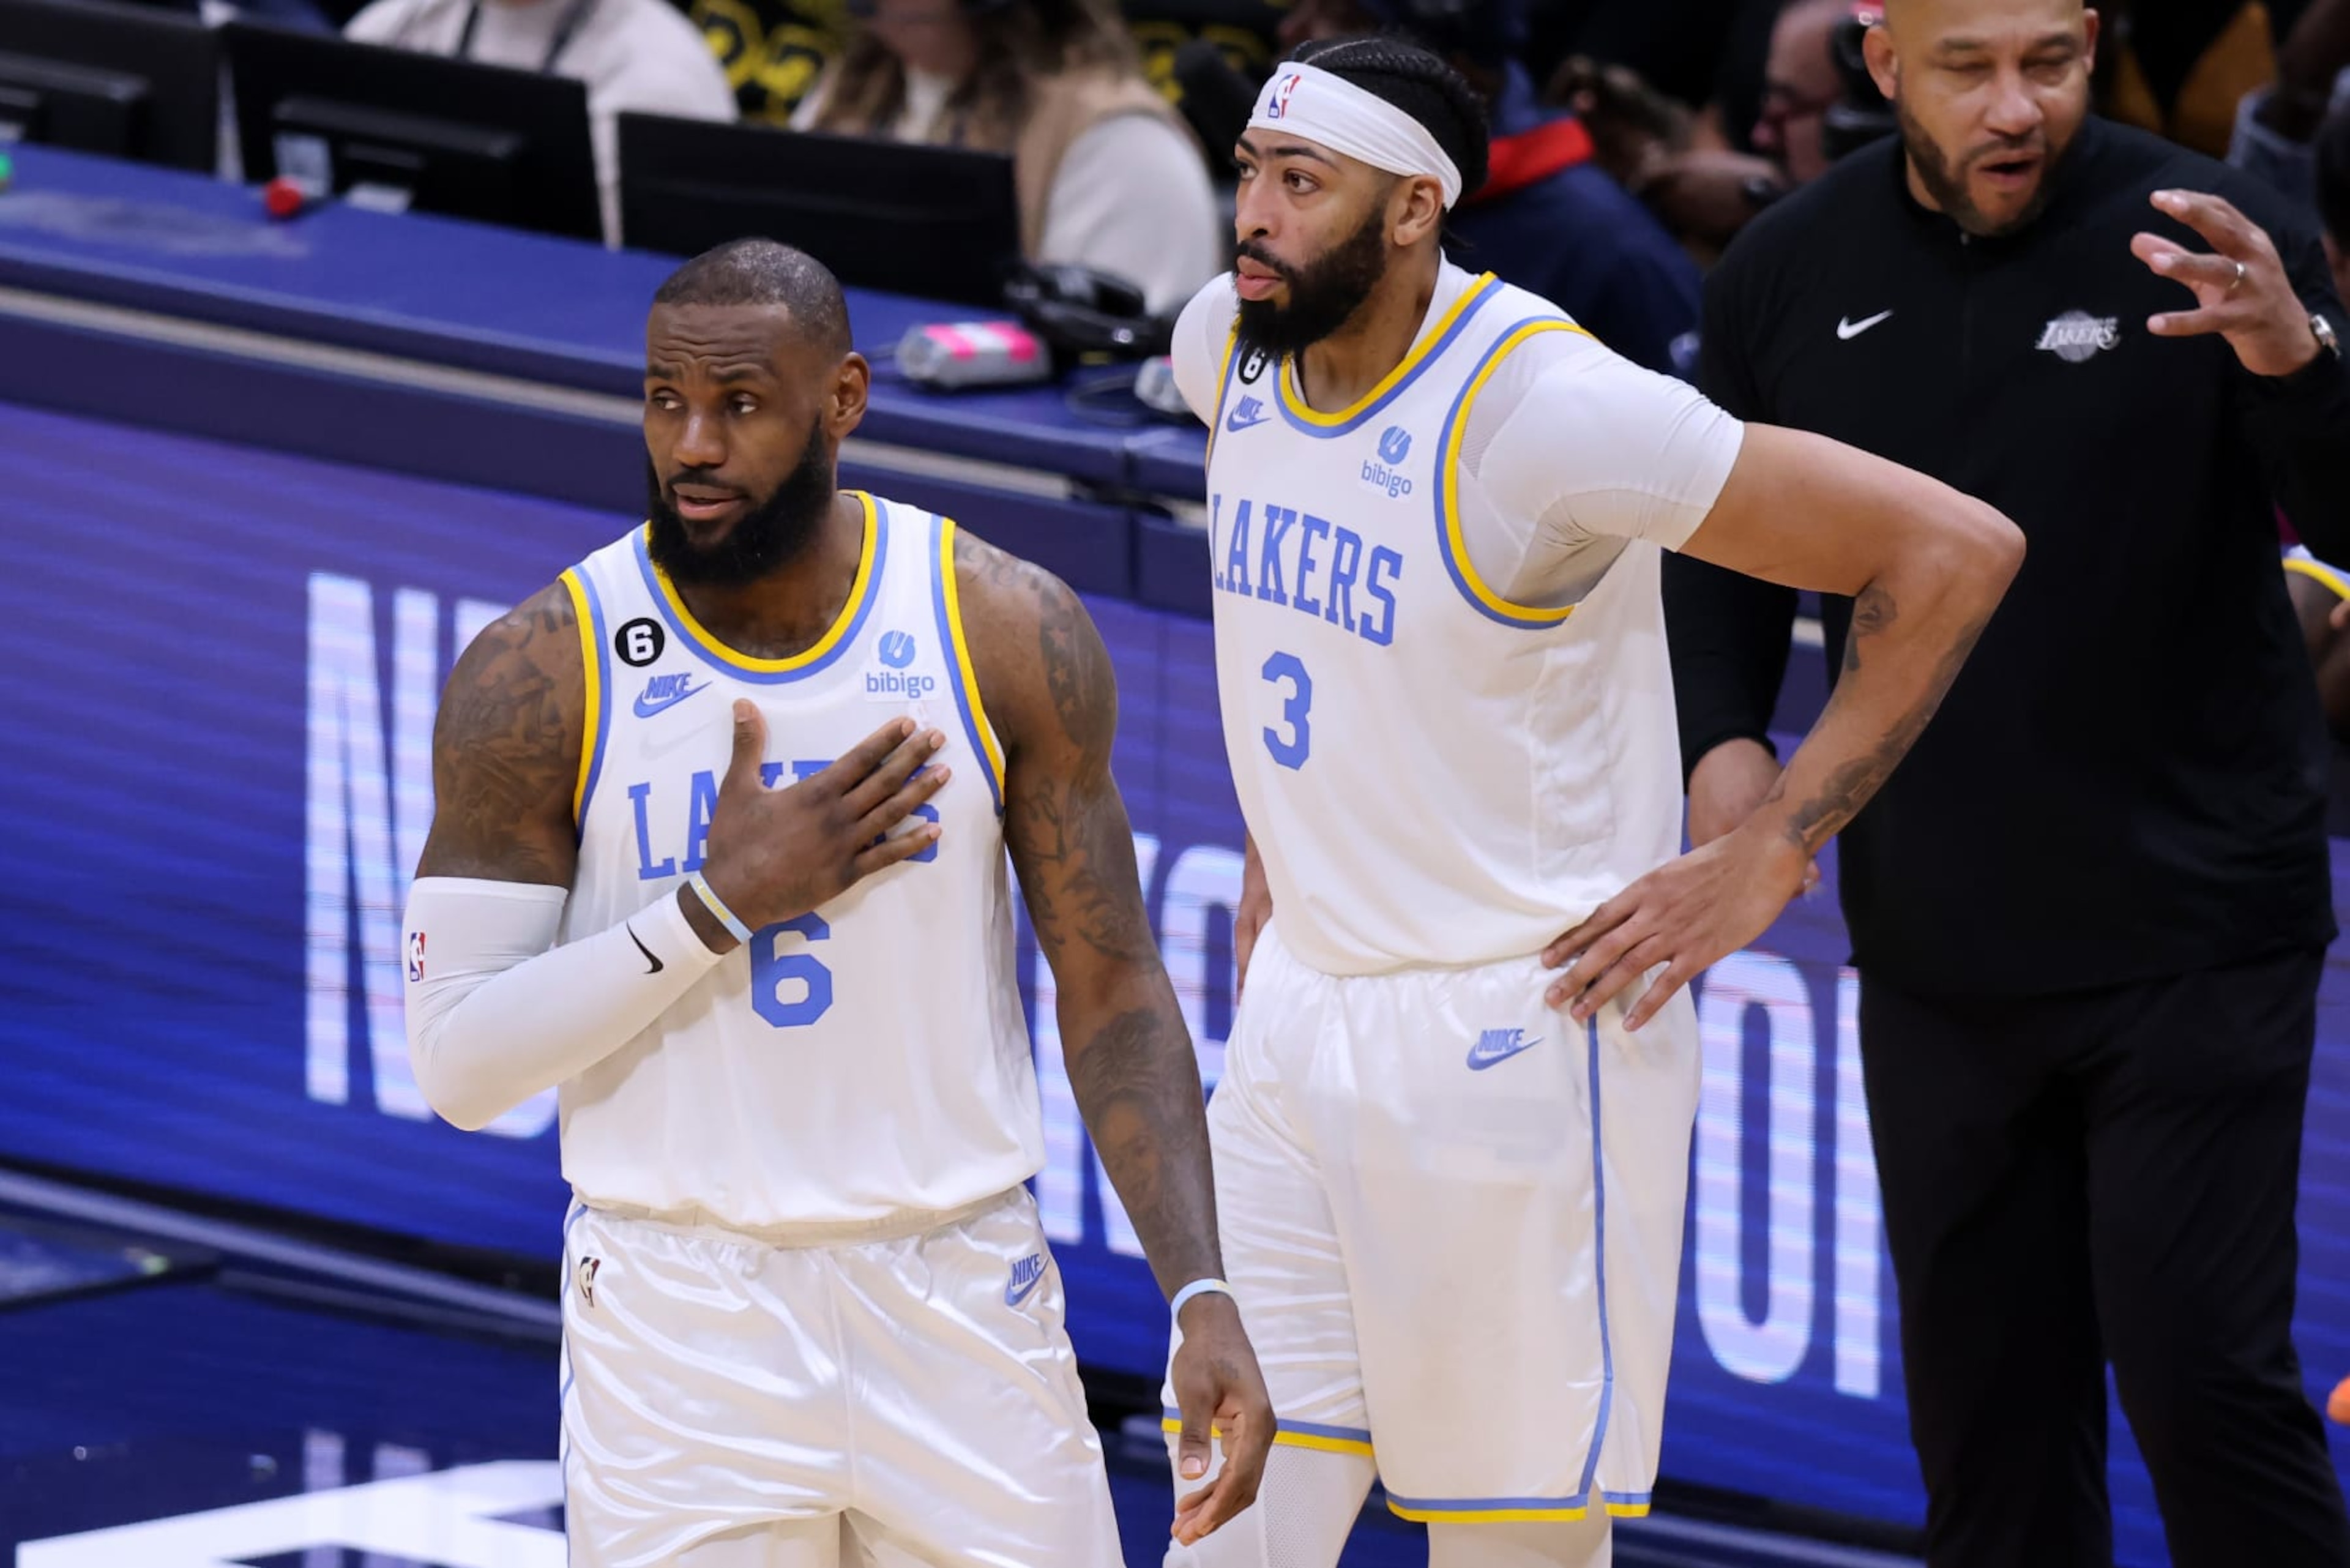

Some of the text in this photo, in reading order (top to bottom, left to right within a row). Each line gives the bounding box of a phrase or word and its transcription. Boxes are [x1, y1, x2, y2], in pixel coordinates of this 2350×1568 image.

[1361, 460, 1412, 498] bibigo
[1212, 494, 1403, 646] LAKERS
[626, 624, 655, 662] 6
[644, 673, 692, 699] NIKE
[866, 673, 934, 698] bibigo
[1262, 651, 1311, 771] 3
[749, 911, 832, 1028] 6
[1477, 1028, 1525, 1051] NIKE
[1012, 1253, 1039, 1287] NIKE
